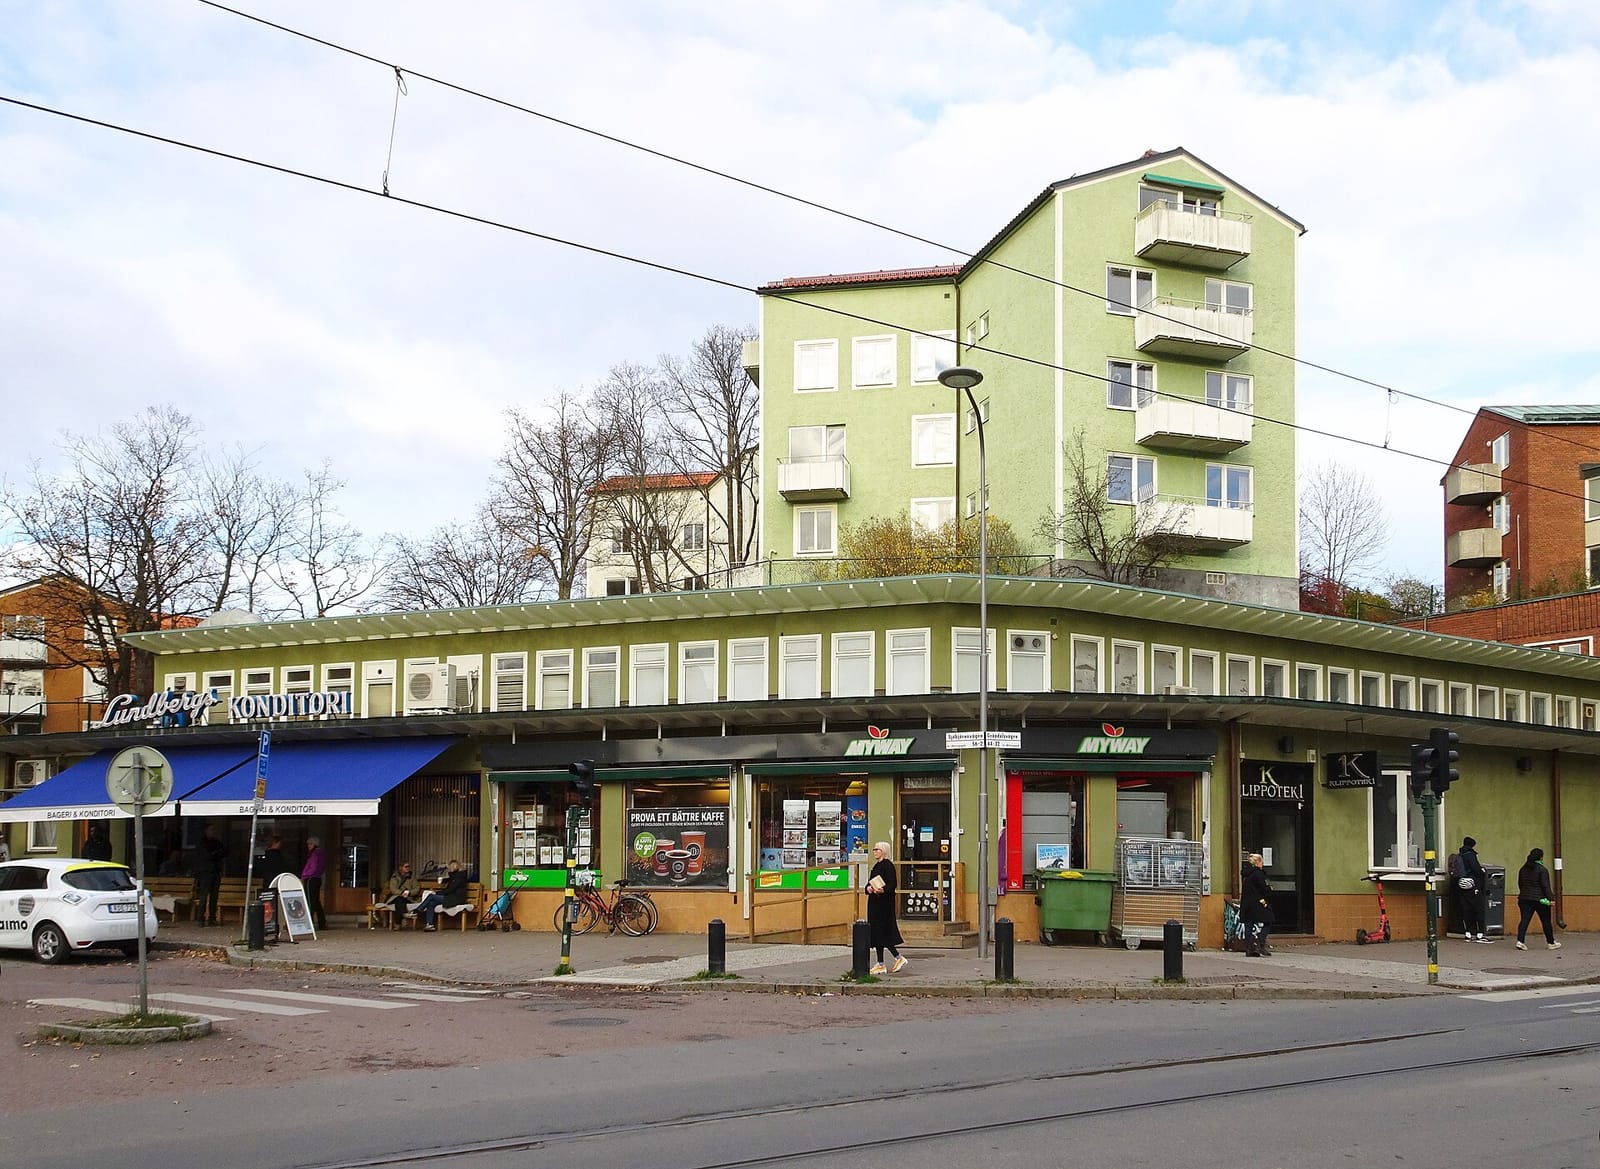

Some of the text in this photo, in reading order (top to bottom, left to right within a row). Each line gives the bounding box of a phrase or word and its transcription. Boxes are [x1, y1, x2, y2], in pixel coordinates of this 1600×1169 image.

[90, 689, 353, 728] Lundbergs KONDITORI
[261, 733, 269, 753] P
[844, 738, 915, 756] MYWAY
[1078, 737, 1150, 753] MYWAY
[1240, 783, 1303, 800] LIPPOTEK1
[47, 811, 72, 819] BAGERI
[79, 809, 116, 818] KONDITORI
[275, 805, 316, 813] KONDITORI
[631, 810, 725, 823] PROVA ETT BÄTTRE KAFFE
[636, 840, 643, 850] to
